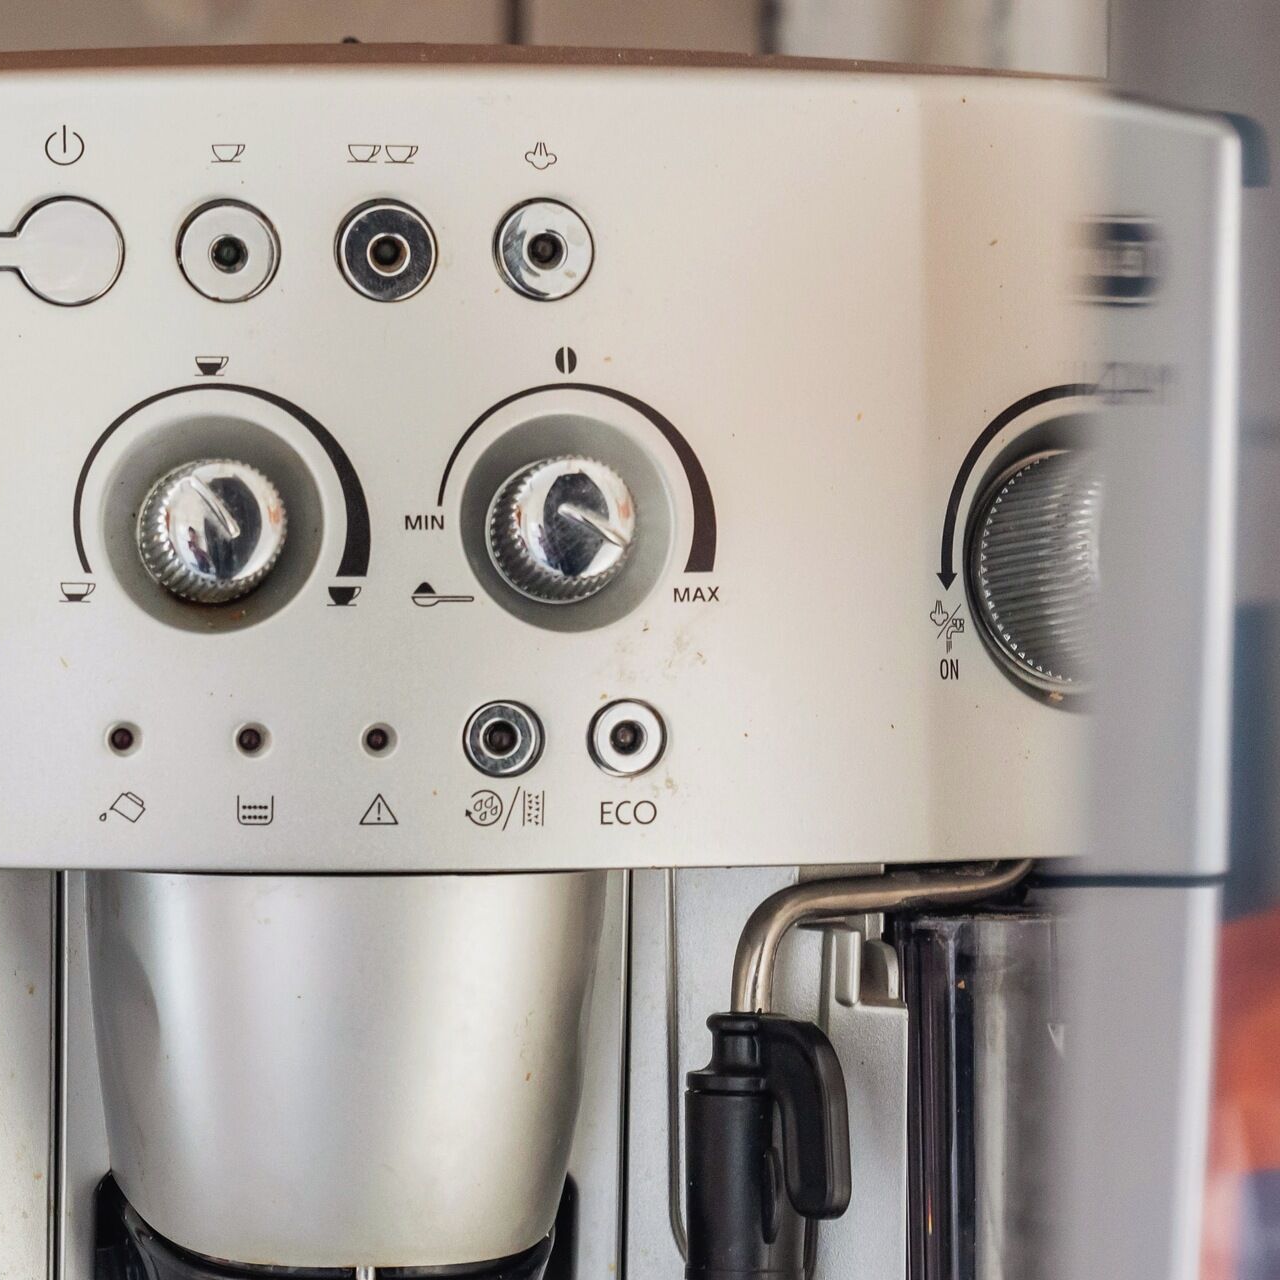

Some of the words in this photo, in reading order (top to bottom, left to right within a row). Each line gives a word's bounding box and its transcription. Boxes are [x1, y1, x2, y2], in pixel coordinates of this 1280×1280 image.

[404, 514, 446, 531] MIN
[673, 586, 721, 603] MAX
[939, 658, 960, 681] ON
[600, 800, 658, 826] ECO
